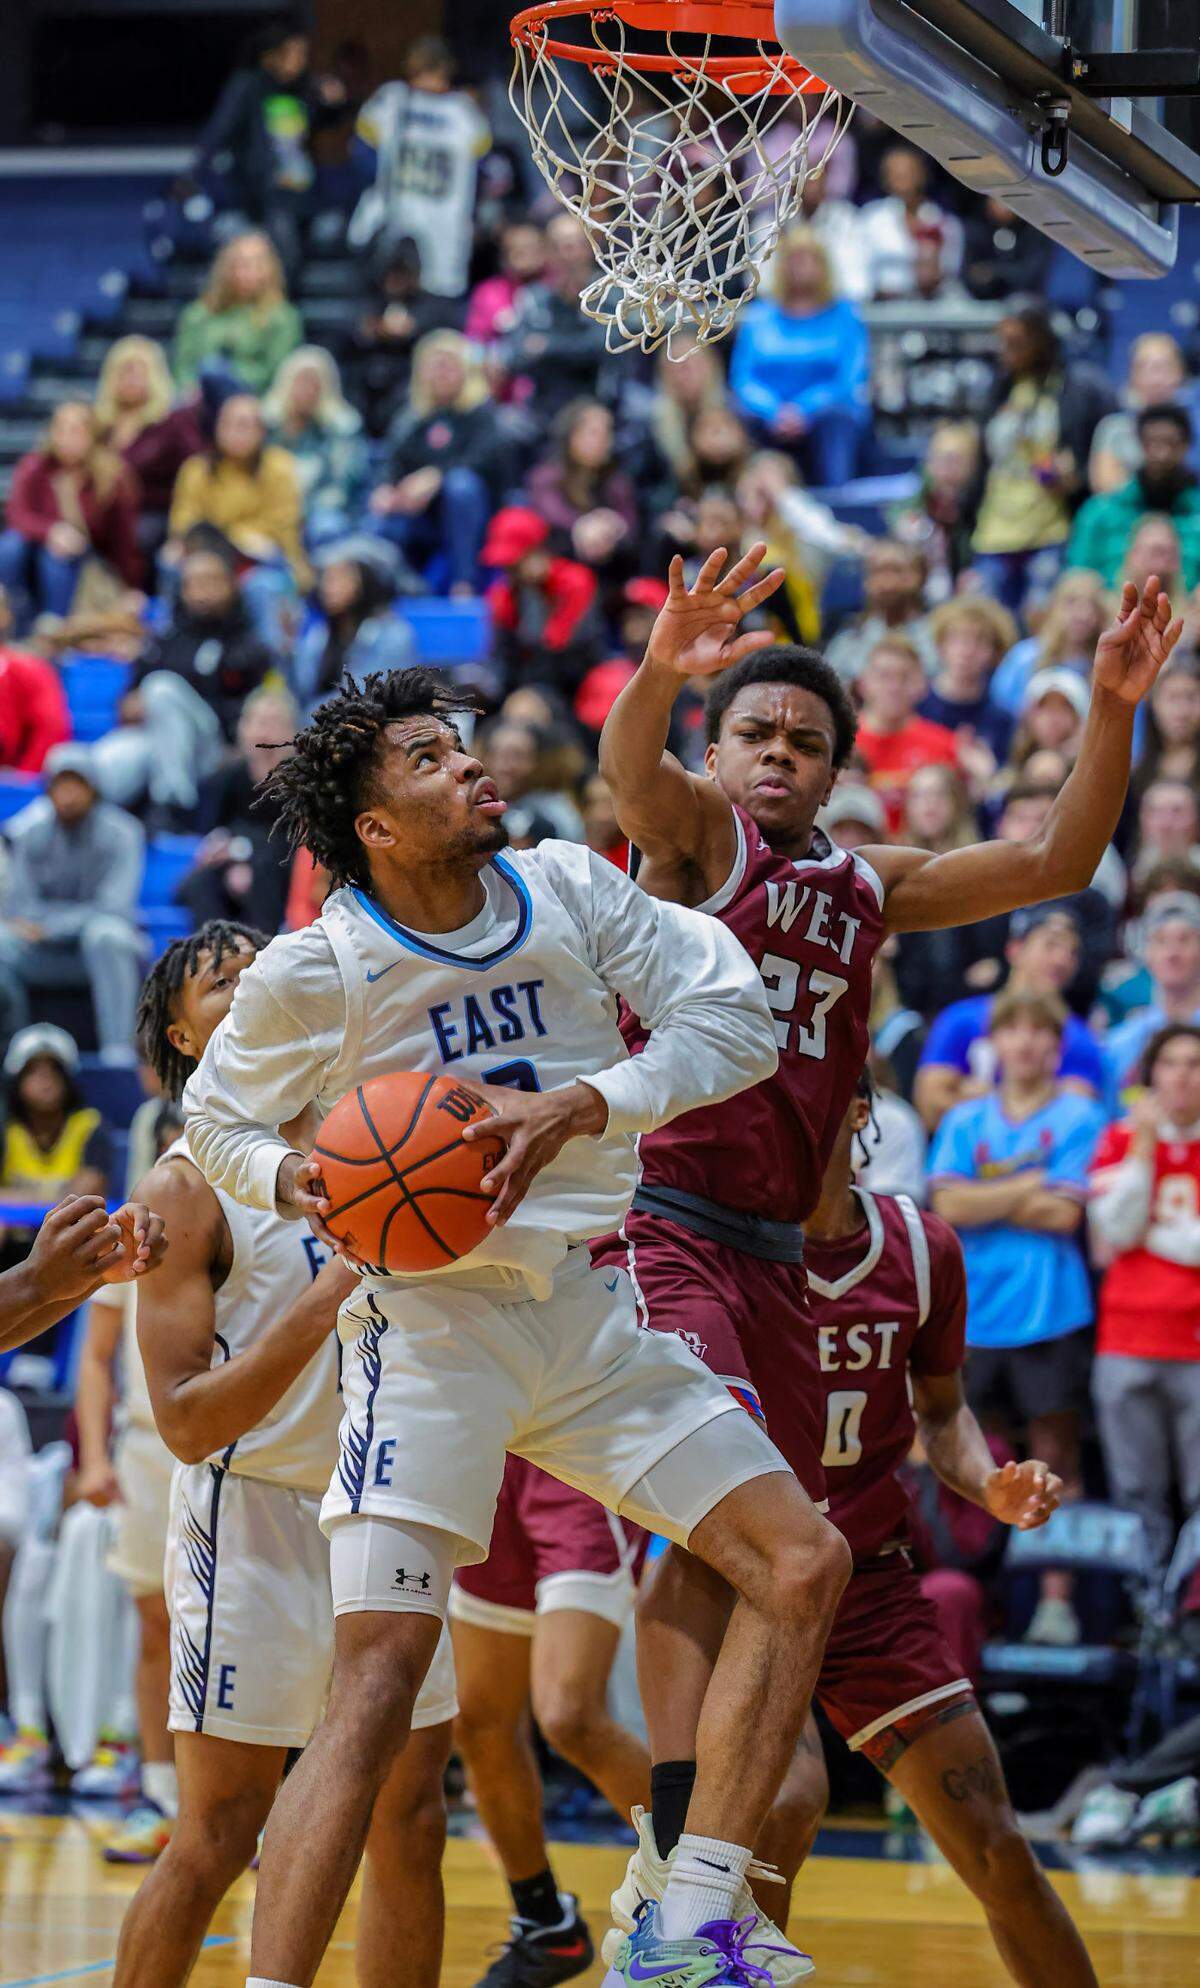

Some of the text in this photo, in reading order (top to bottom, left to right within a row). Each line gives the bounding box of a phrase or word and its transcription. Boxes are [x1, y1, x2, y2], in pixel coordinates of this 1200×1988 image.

[427, 979, 548, 1065] EAST
[759, 952, 850, 1061] 23
[373, 1438, 397, 1487] E
[820, 1390, 868, 1467] 0
[217, 1664, 237, 1710] E
